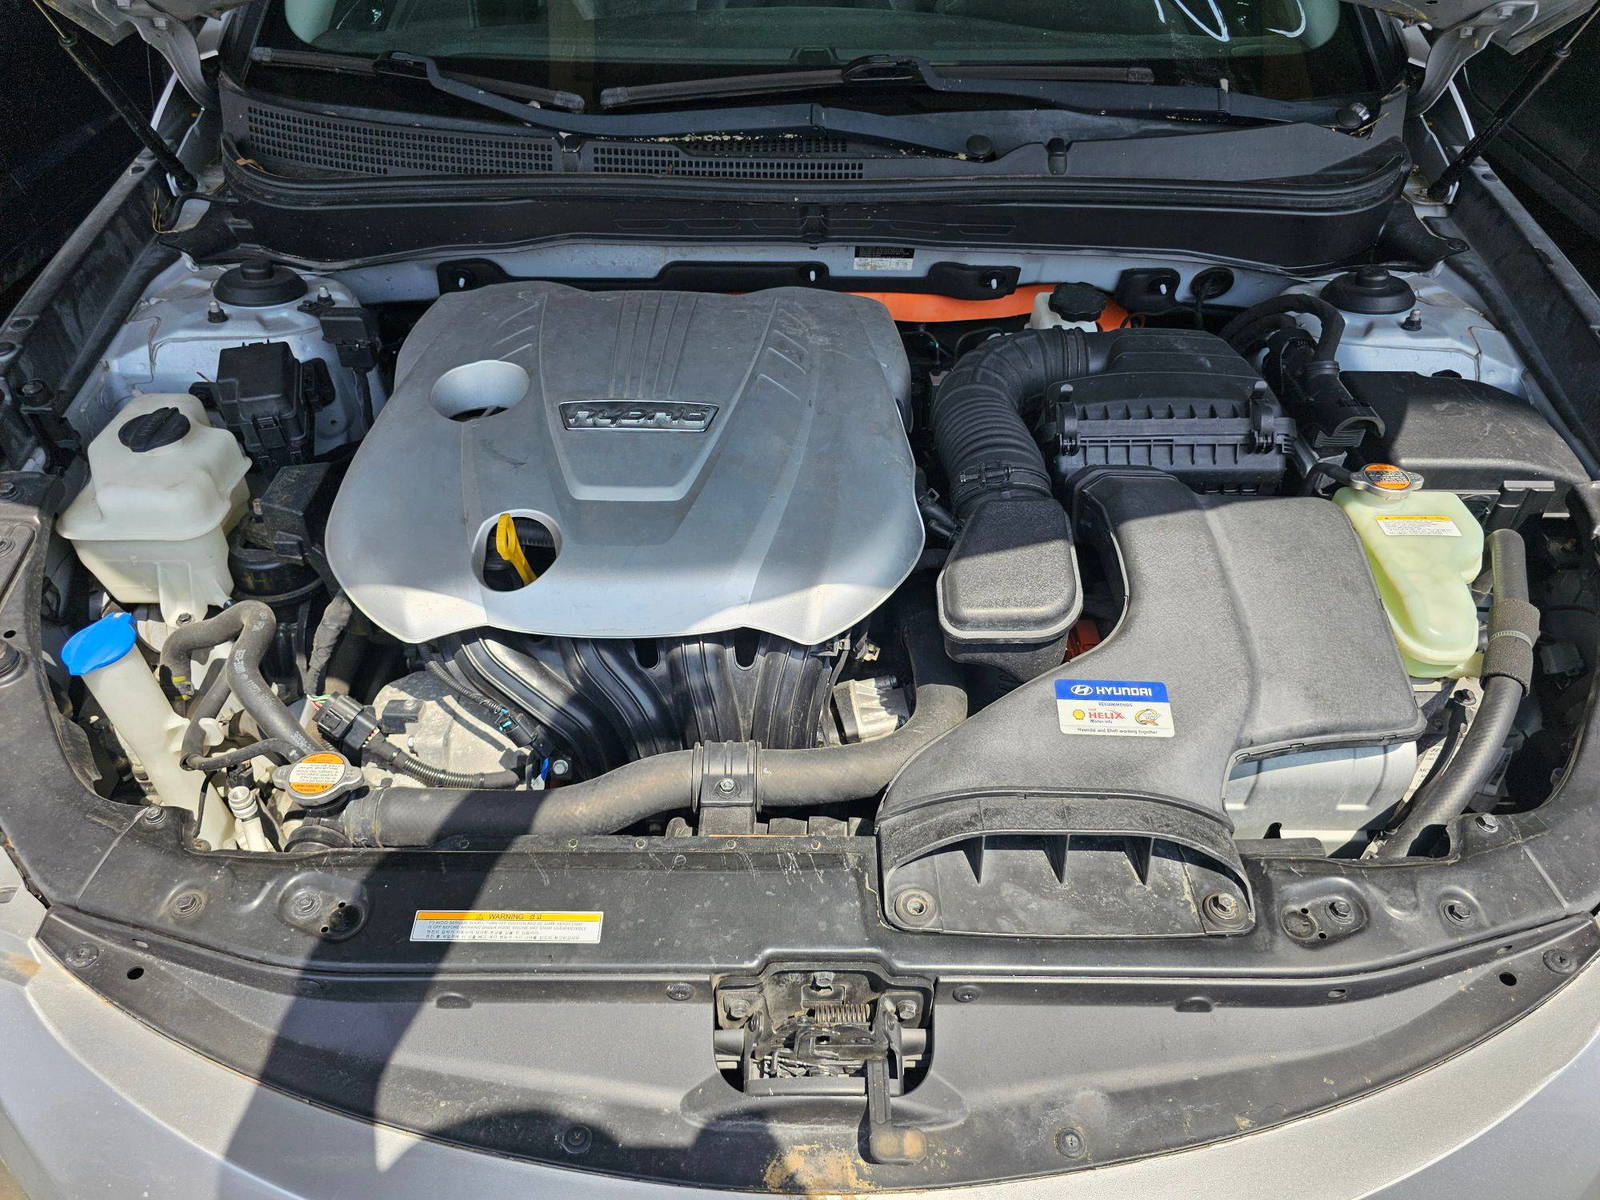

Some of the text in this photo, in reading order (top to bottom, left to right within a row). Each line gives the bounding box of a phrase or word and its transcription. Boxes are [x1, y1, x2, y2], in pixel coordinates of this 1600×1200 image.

[1095, 686, 1153, 697] HYUNDAI
[1088, 711, 1124, 720] HELIX
[489, 912, 524, 920] WARNING
